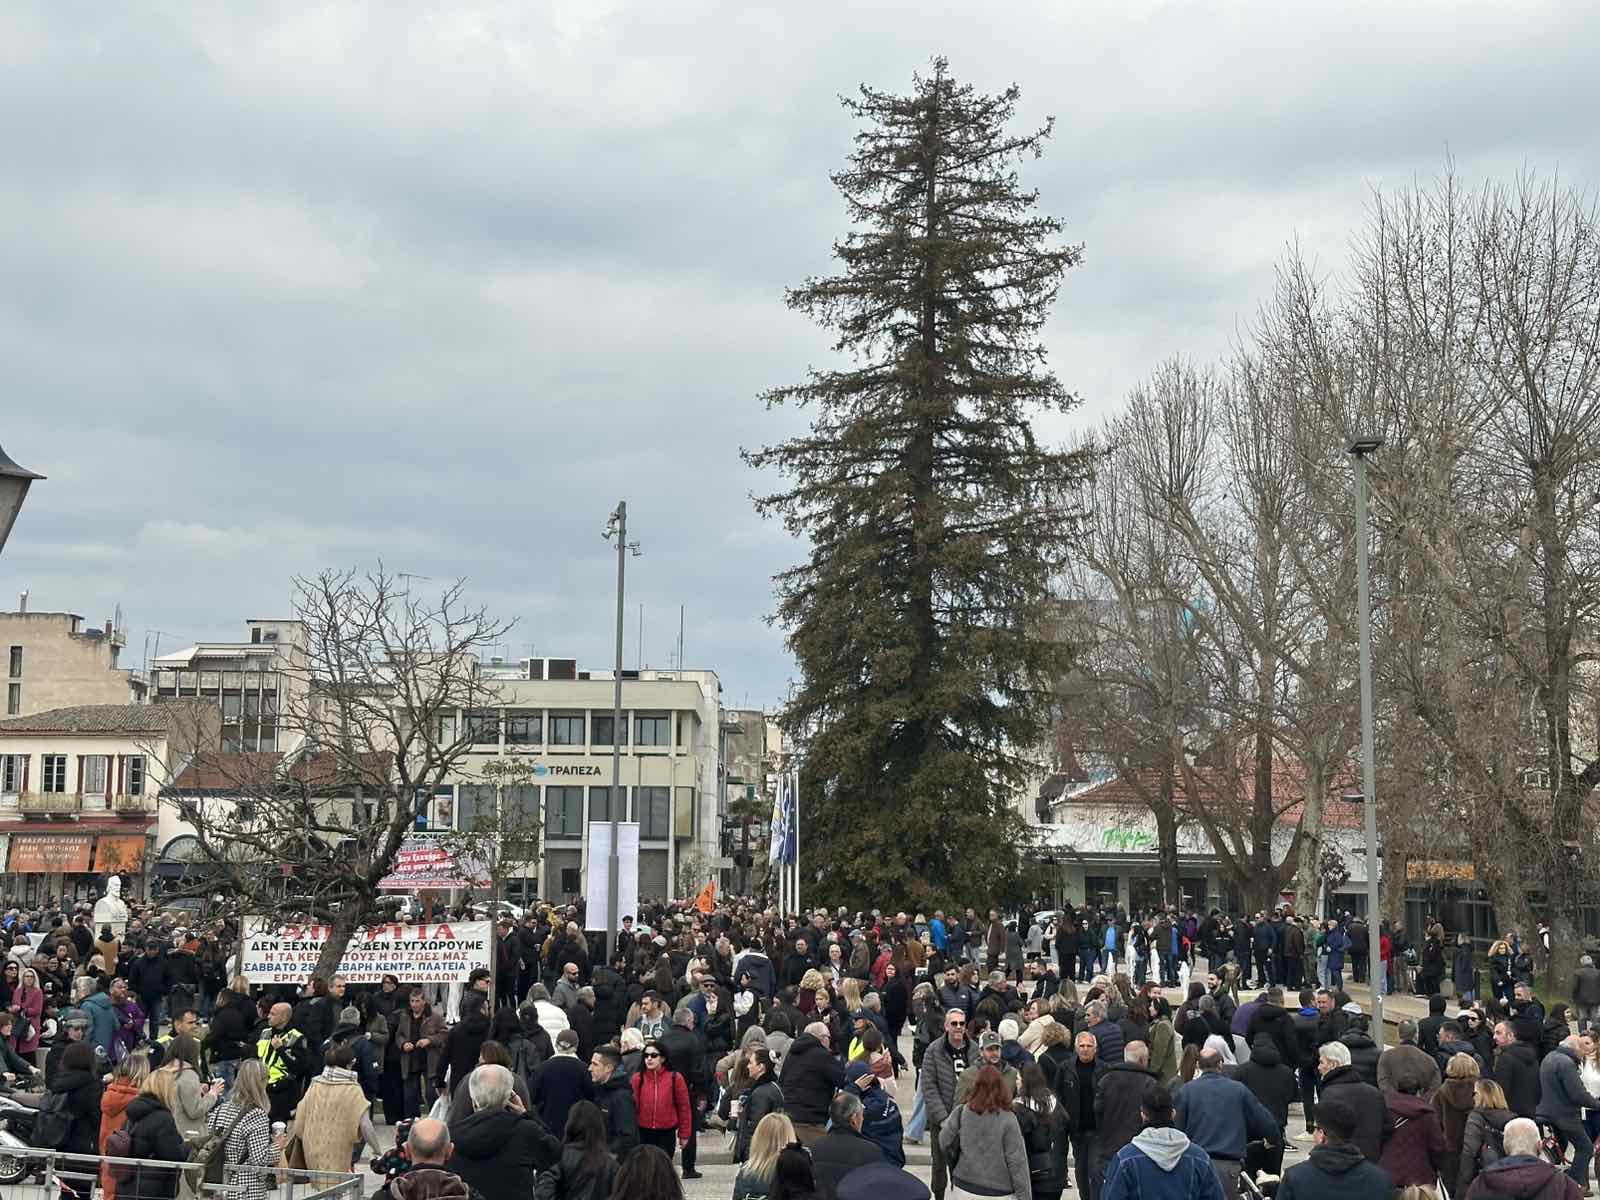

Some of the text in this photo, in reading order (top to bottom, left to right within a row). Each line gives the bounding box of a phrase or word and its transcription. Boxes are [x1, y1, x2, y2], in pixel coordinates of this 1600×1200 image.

[548, 766, 602, 776] ΤΡΑΠΕΖΑ
[281, 923, 456, 941] ΑΠΡΓΙΑ
[251, 941, 279, 951] ΔΕΝ
[363, 941, 389, 951] ΔΕΝ
[394, 940, 484, 951] ΣΥΓΧΩΡΟΥΜΕ
[265, 952, 273, 962] Η
[279, 952, 293, 962] ΤΑ
[343, 952, 376, 962] ΤΟΥΣ
[379, 952, 387, 961] Η
[391, 952, 403, 961] ΟΙ
[408, 952, 439, 961] ΖΩΕΣ
[443, 952, 469, 961] ΜΑΣ
[244, 963, 297, 972] ΣΑΒΒΑΤΟ
[376, 962, 415, 971] ΚΕΝΤΡ.
[418, 962, 466, 971] ΠΛΑΤΕΙΑ
[343, 973, 387, 982] ΚΕΝΤΡ
[398, 972, 459, 981] ΤΡΙΚΑΛΩΝ
